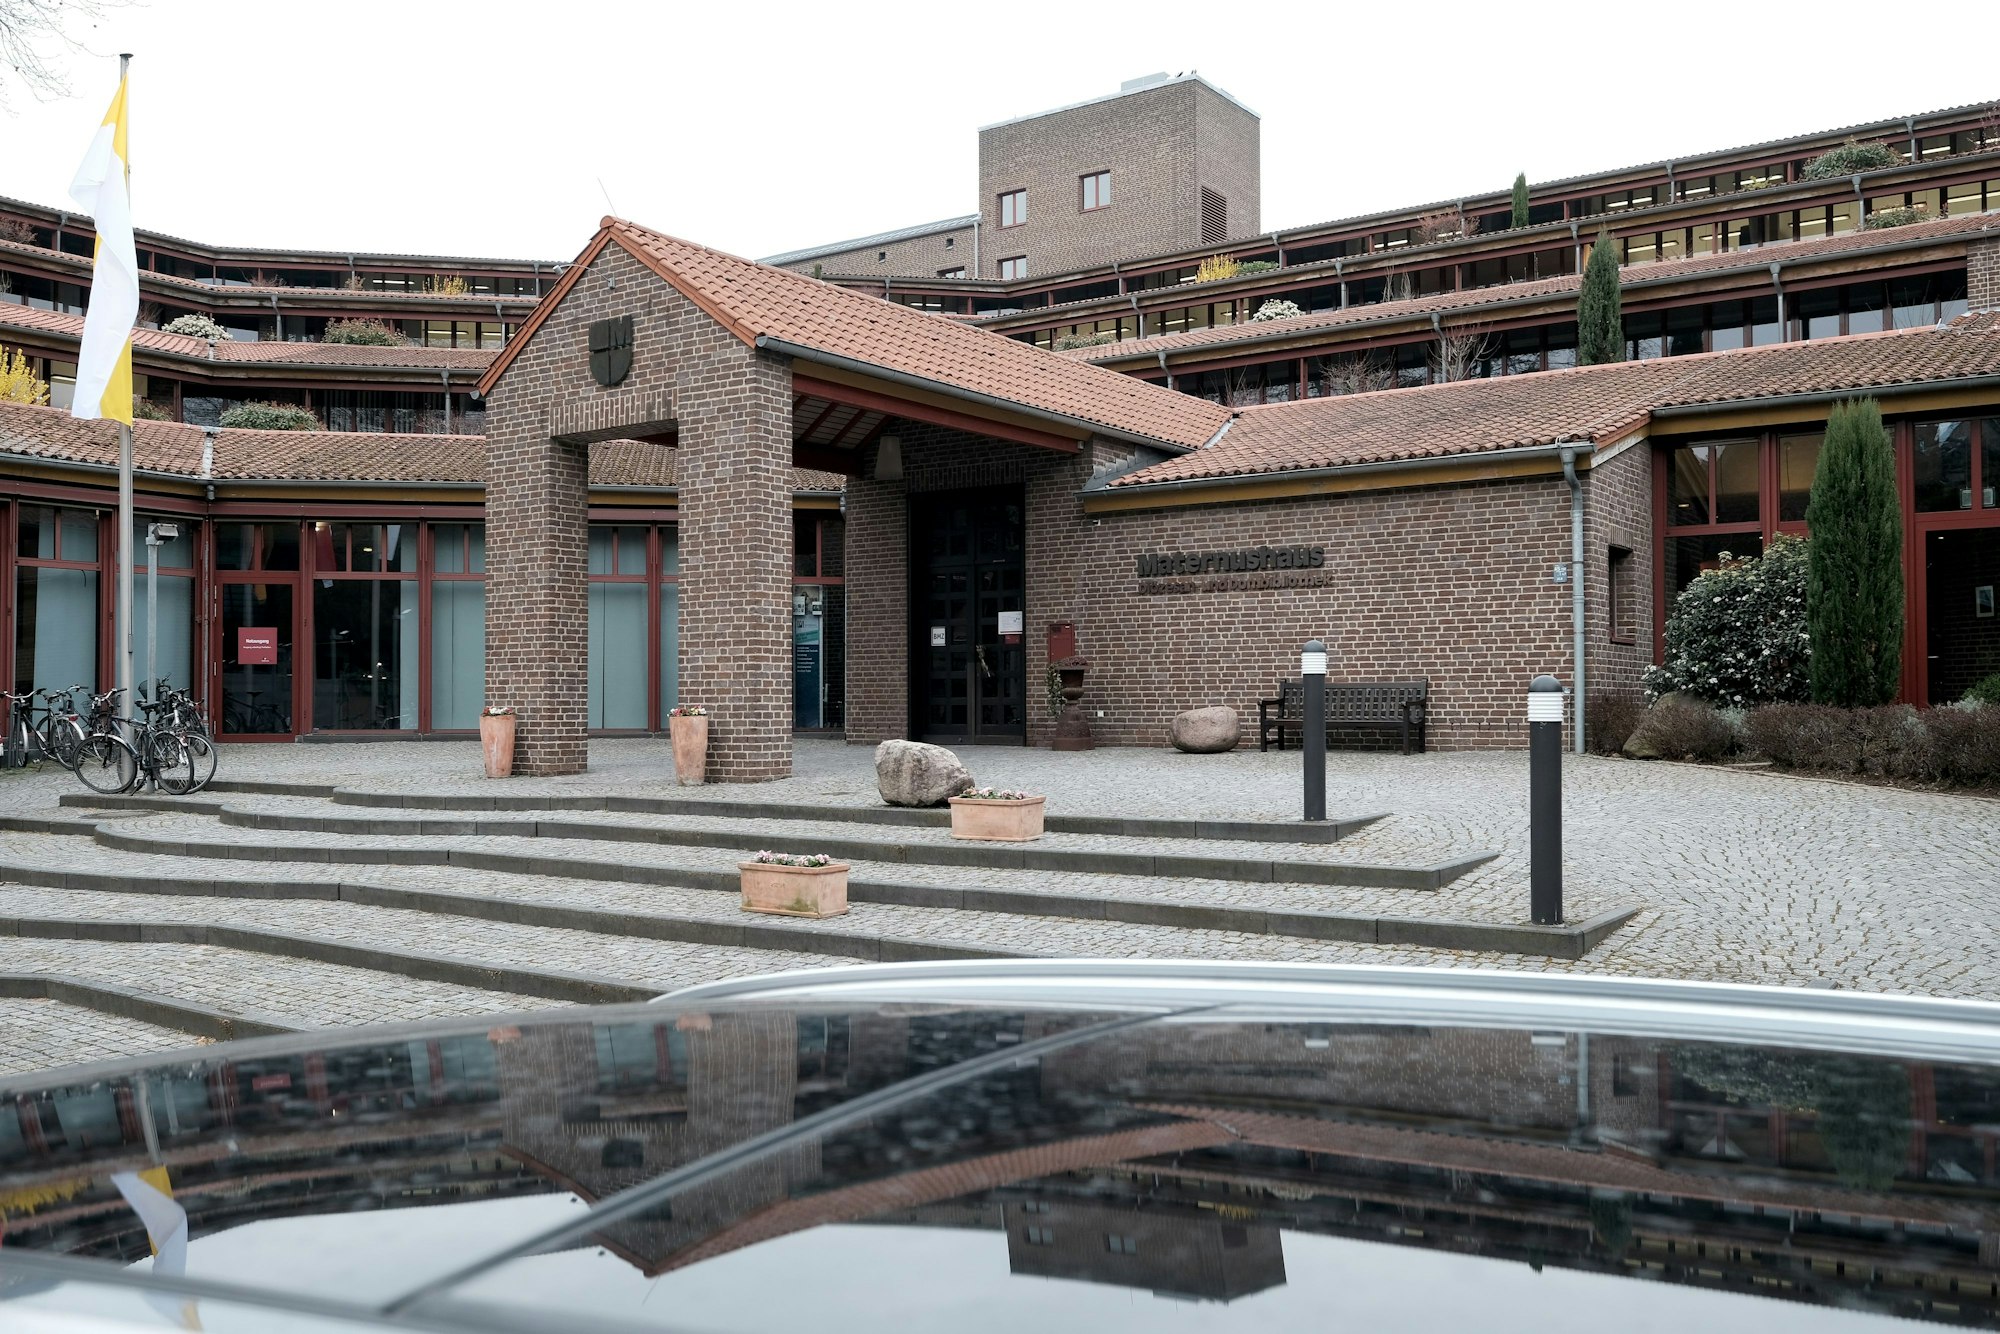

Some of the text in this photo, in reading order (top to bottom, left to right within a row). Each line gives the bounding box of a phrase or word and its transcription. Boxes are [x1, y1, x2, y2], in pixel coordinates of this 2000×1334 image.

[1137, 545, 1325, 577] Maternushaus
[1202, 578, 1228, 593] und
[1230, 574, 1333, 591] Dombibliothek
